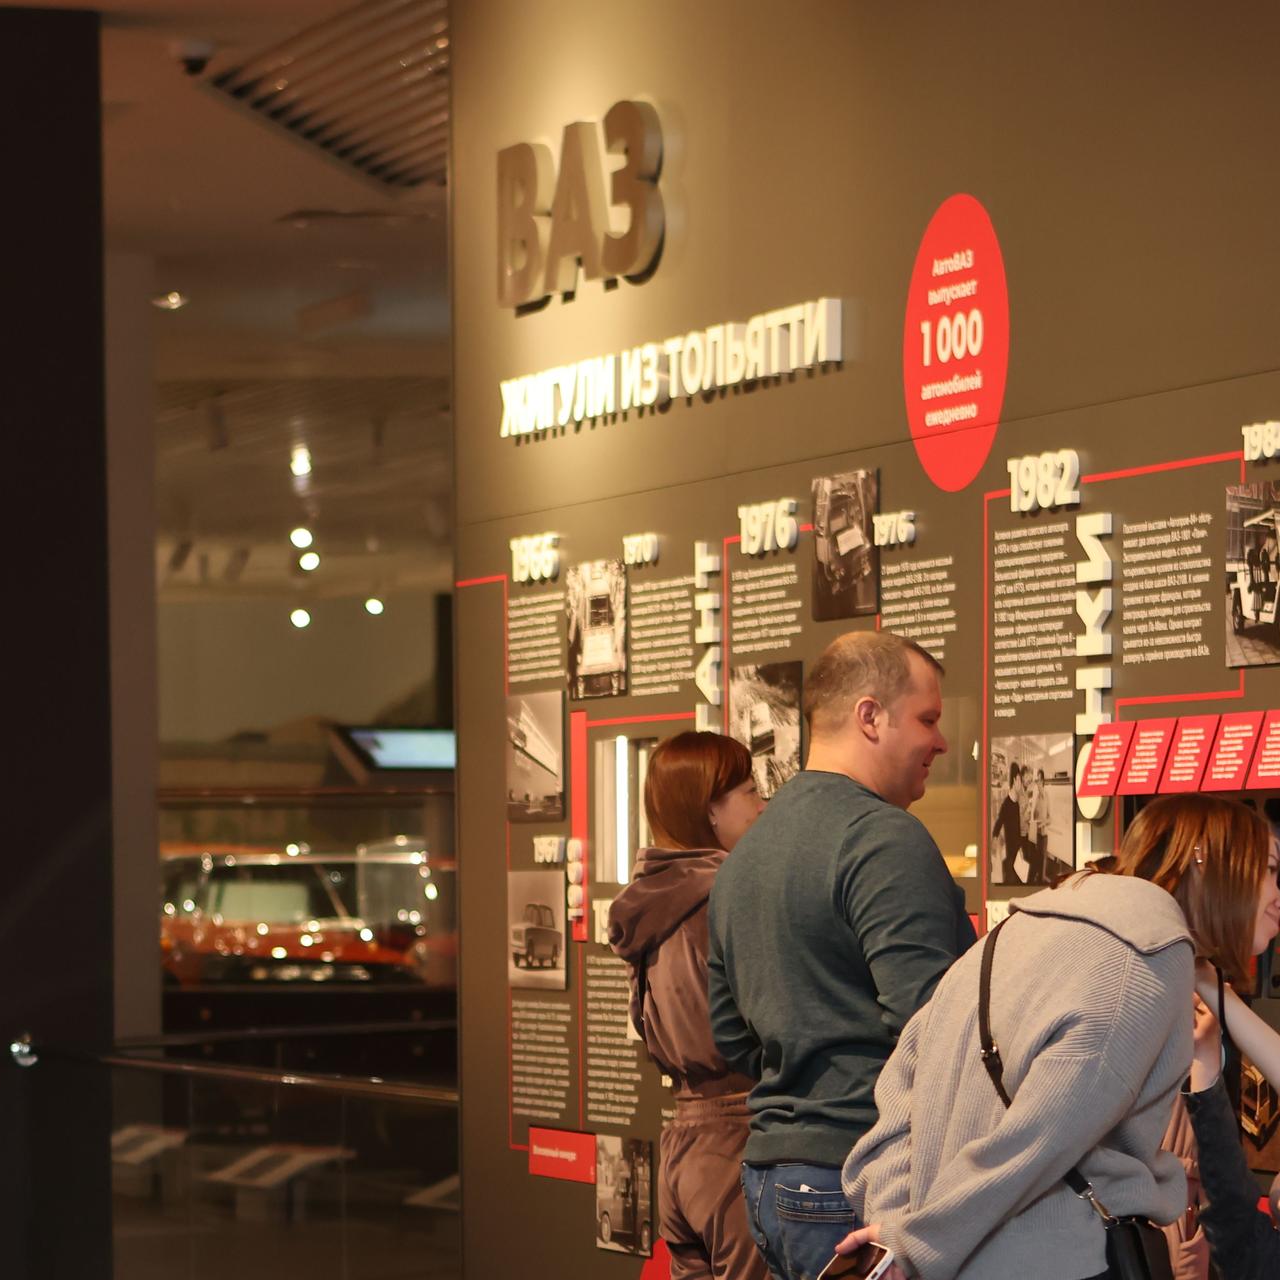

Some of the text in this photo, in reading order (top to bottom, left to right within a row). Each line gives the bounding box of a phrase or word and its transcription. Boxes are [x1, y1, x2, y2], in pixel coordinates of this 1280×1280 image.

[497, 99, 665, 308] ВАЗ
[932, 248, 975, 278] АвтоВАЗ
[927, 278, 978, 308] выпускает
[920, 309, 983, 367] 1 000
[500, 297, 842, 438] ЖИГУЛИ ИЗ ТОЛЬЯТТИ
[920, 372, 982, 402] автомобилей
[925, 404, 977, 429] ежедневно
[1007, 449, 1080, 513] 1982
[737, 498, 799, 555] 1976
[872, 510, 916, 546] 1976
